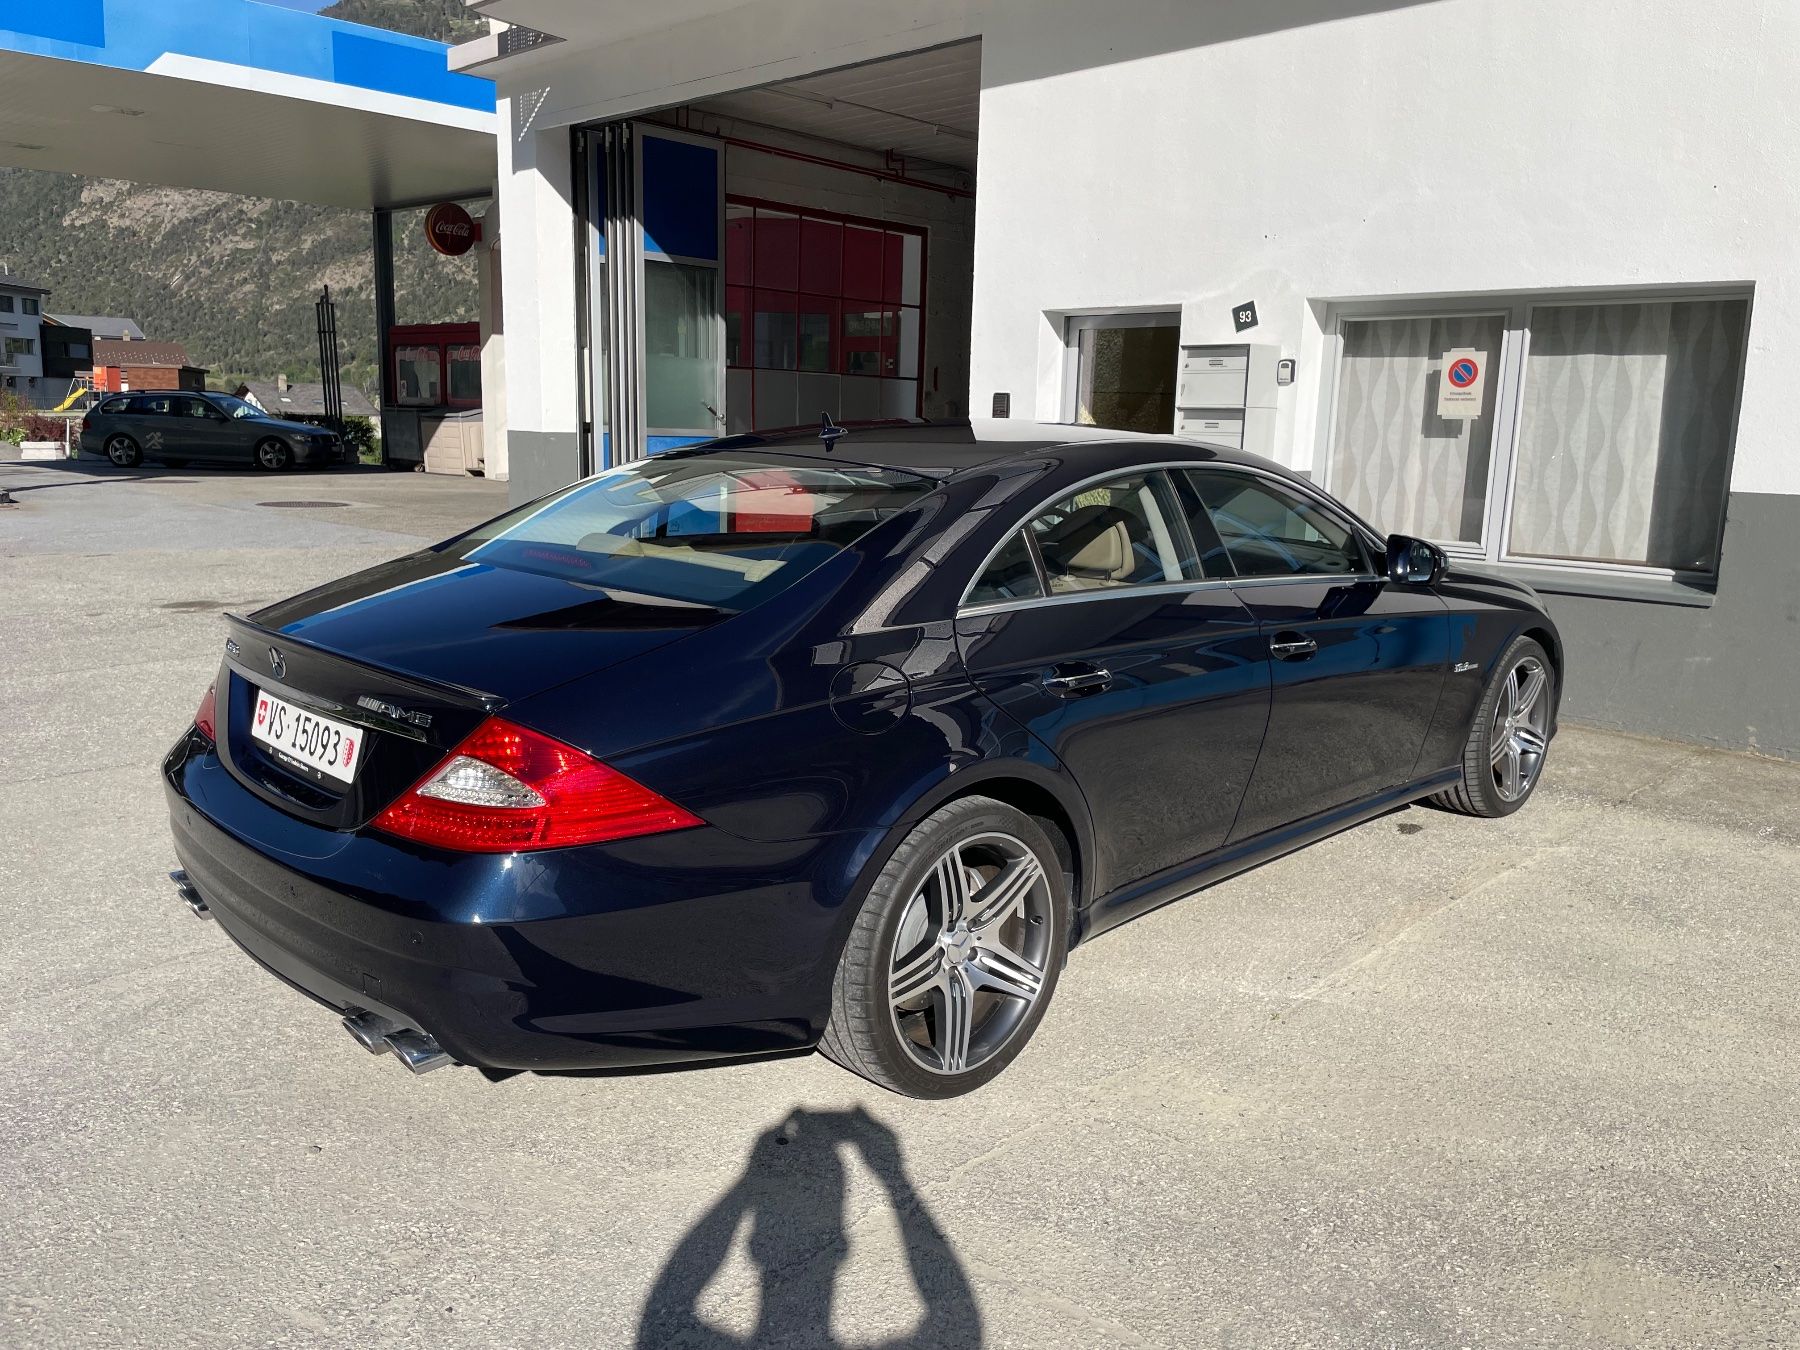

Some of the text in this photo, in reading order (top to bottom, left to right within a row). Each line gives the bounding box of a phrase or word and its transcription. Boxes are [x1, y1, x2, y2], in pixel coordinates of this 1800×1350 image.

[435, 220, 470, 237] Coca-Cola
[1239, 310, 1252, 323] 93
[377, 702, 433, 728] AMG
[268, 700, 341, 766] VS 15093
